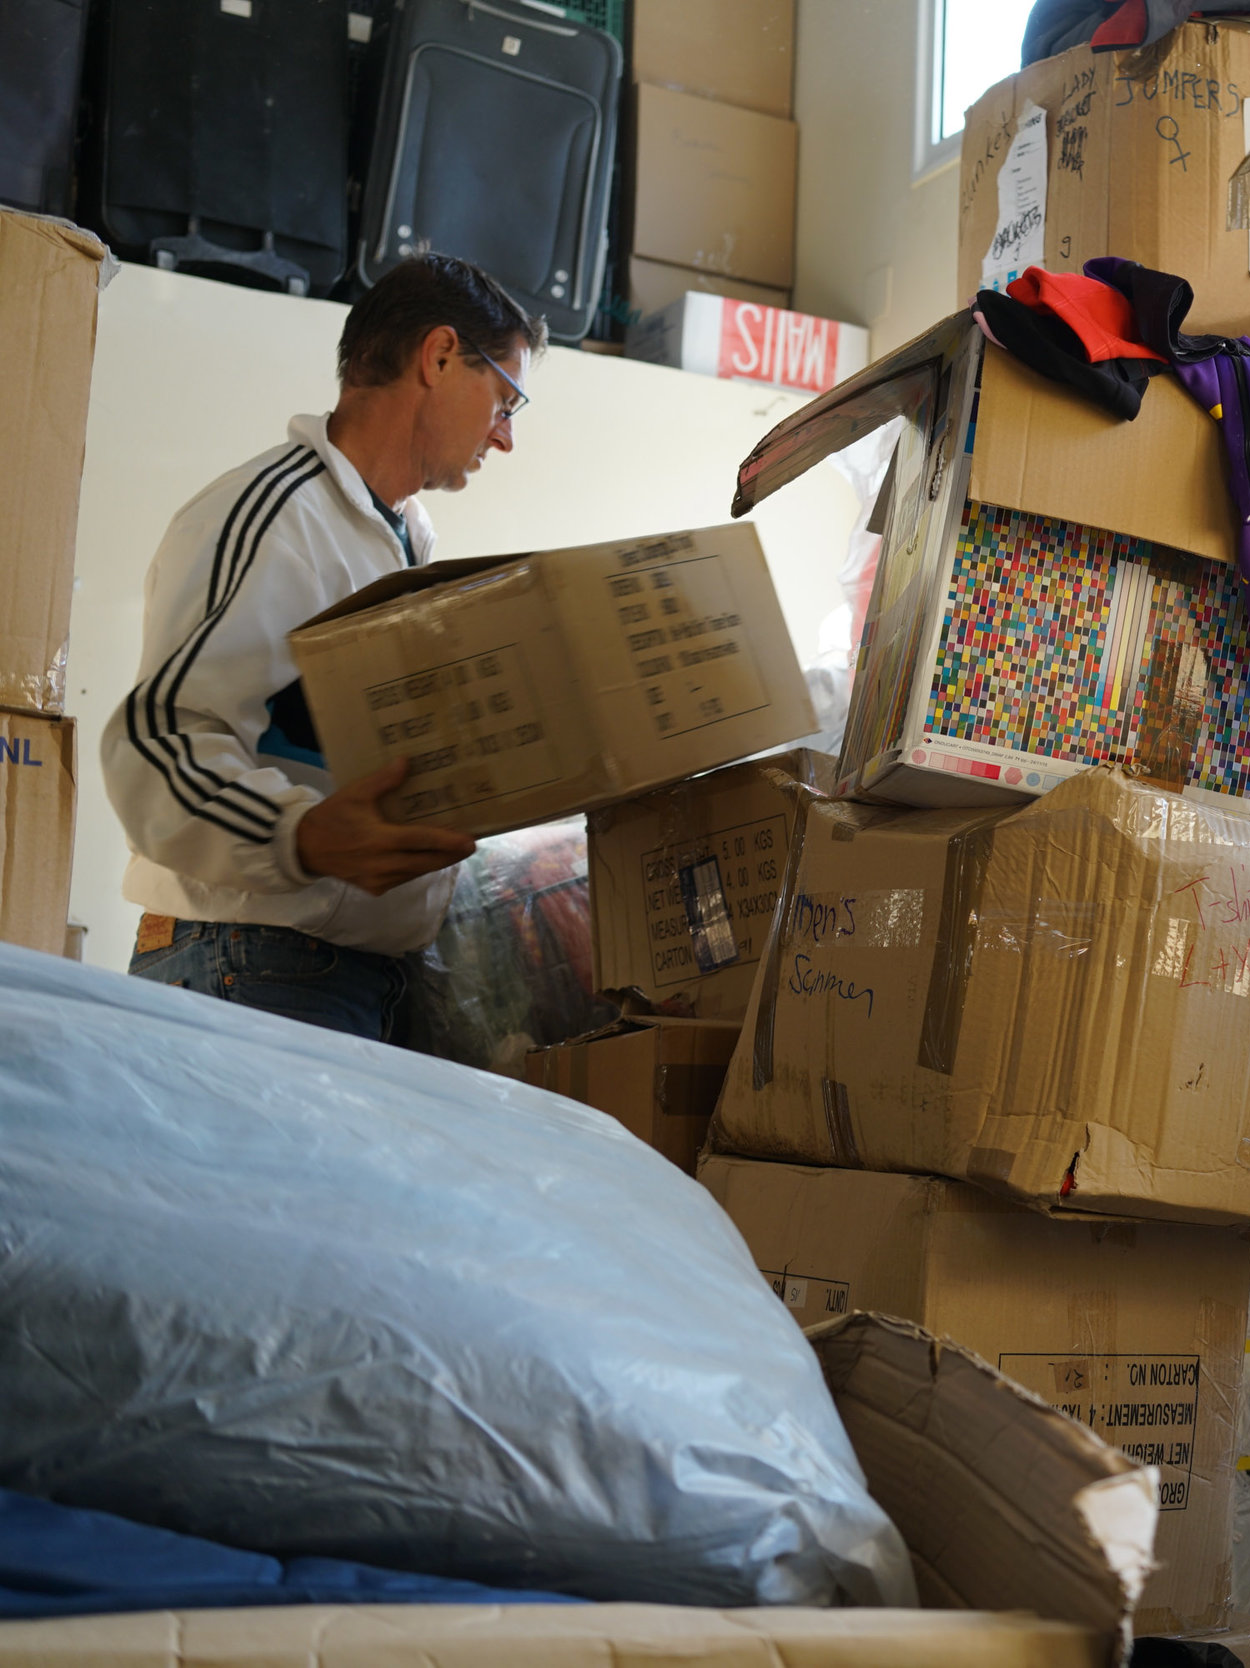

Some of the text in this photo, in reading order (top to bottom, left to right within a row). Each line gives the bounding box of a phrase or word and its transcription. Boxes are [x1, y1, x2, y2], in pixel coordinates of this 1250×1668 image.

[1114, 69, 1240, 117] JUMPERS
[753, 829, 774, 851] KGS
[757, 859, 778, 881] KGS
[1149, 1363, 1197, 1386] CARTON
[1101, 1403, 1194, 1427] MEASUREMENT:
[1167, 1442, 1190, 1465] NET
